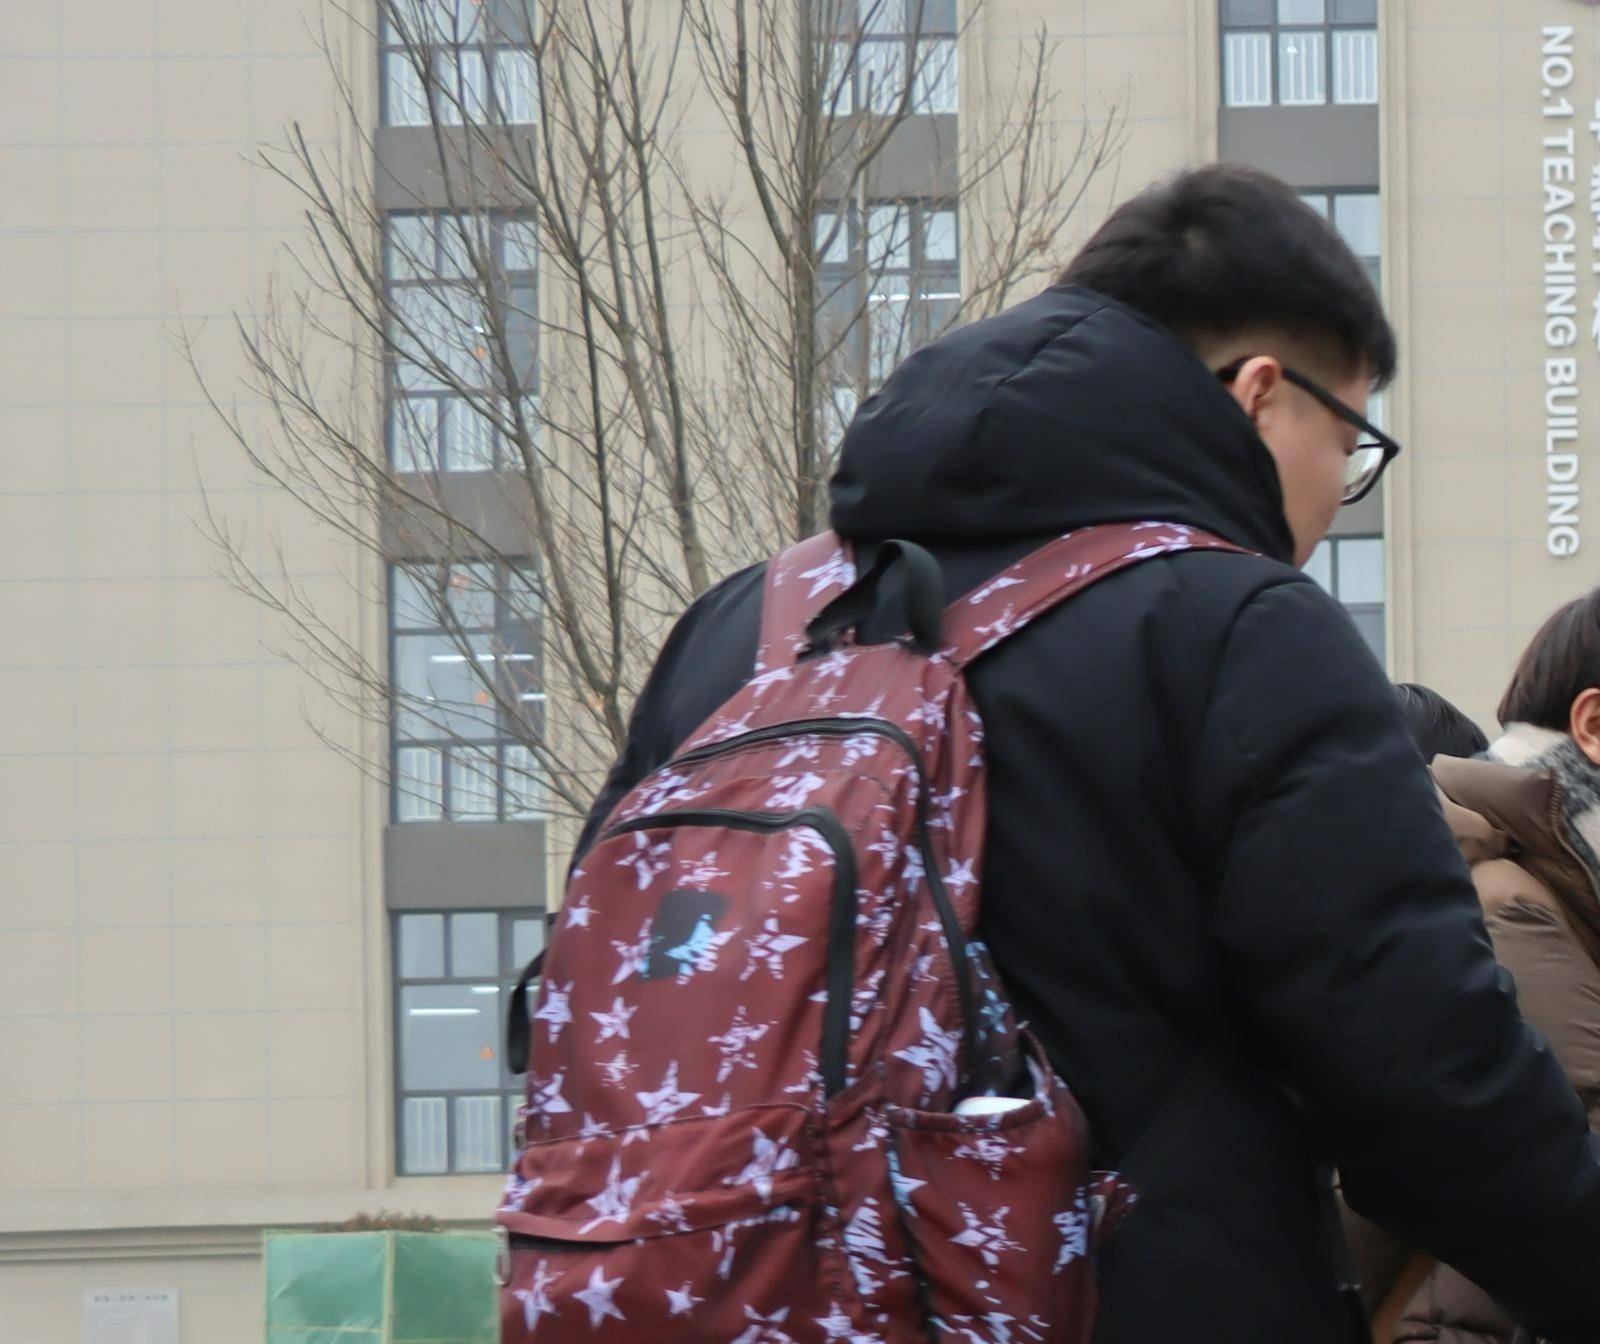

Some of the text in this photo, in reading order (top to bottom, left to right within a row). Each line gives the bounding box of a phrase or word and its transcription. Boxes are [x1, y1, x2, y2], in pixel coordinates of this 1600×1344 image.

[1541, 26, 1580, 556] NO.1 TEACHING BUILDING
